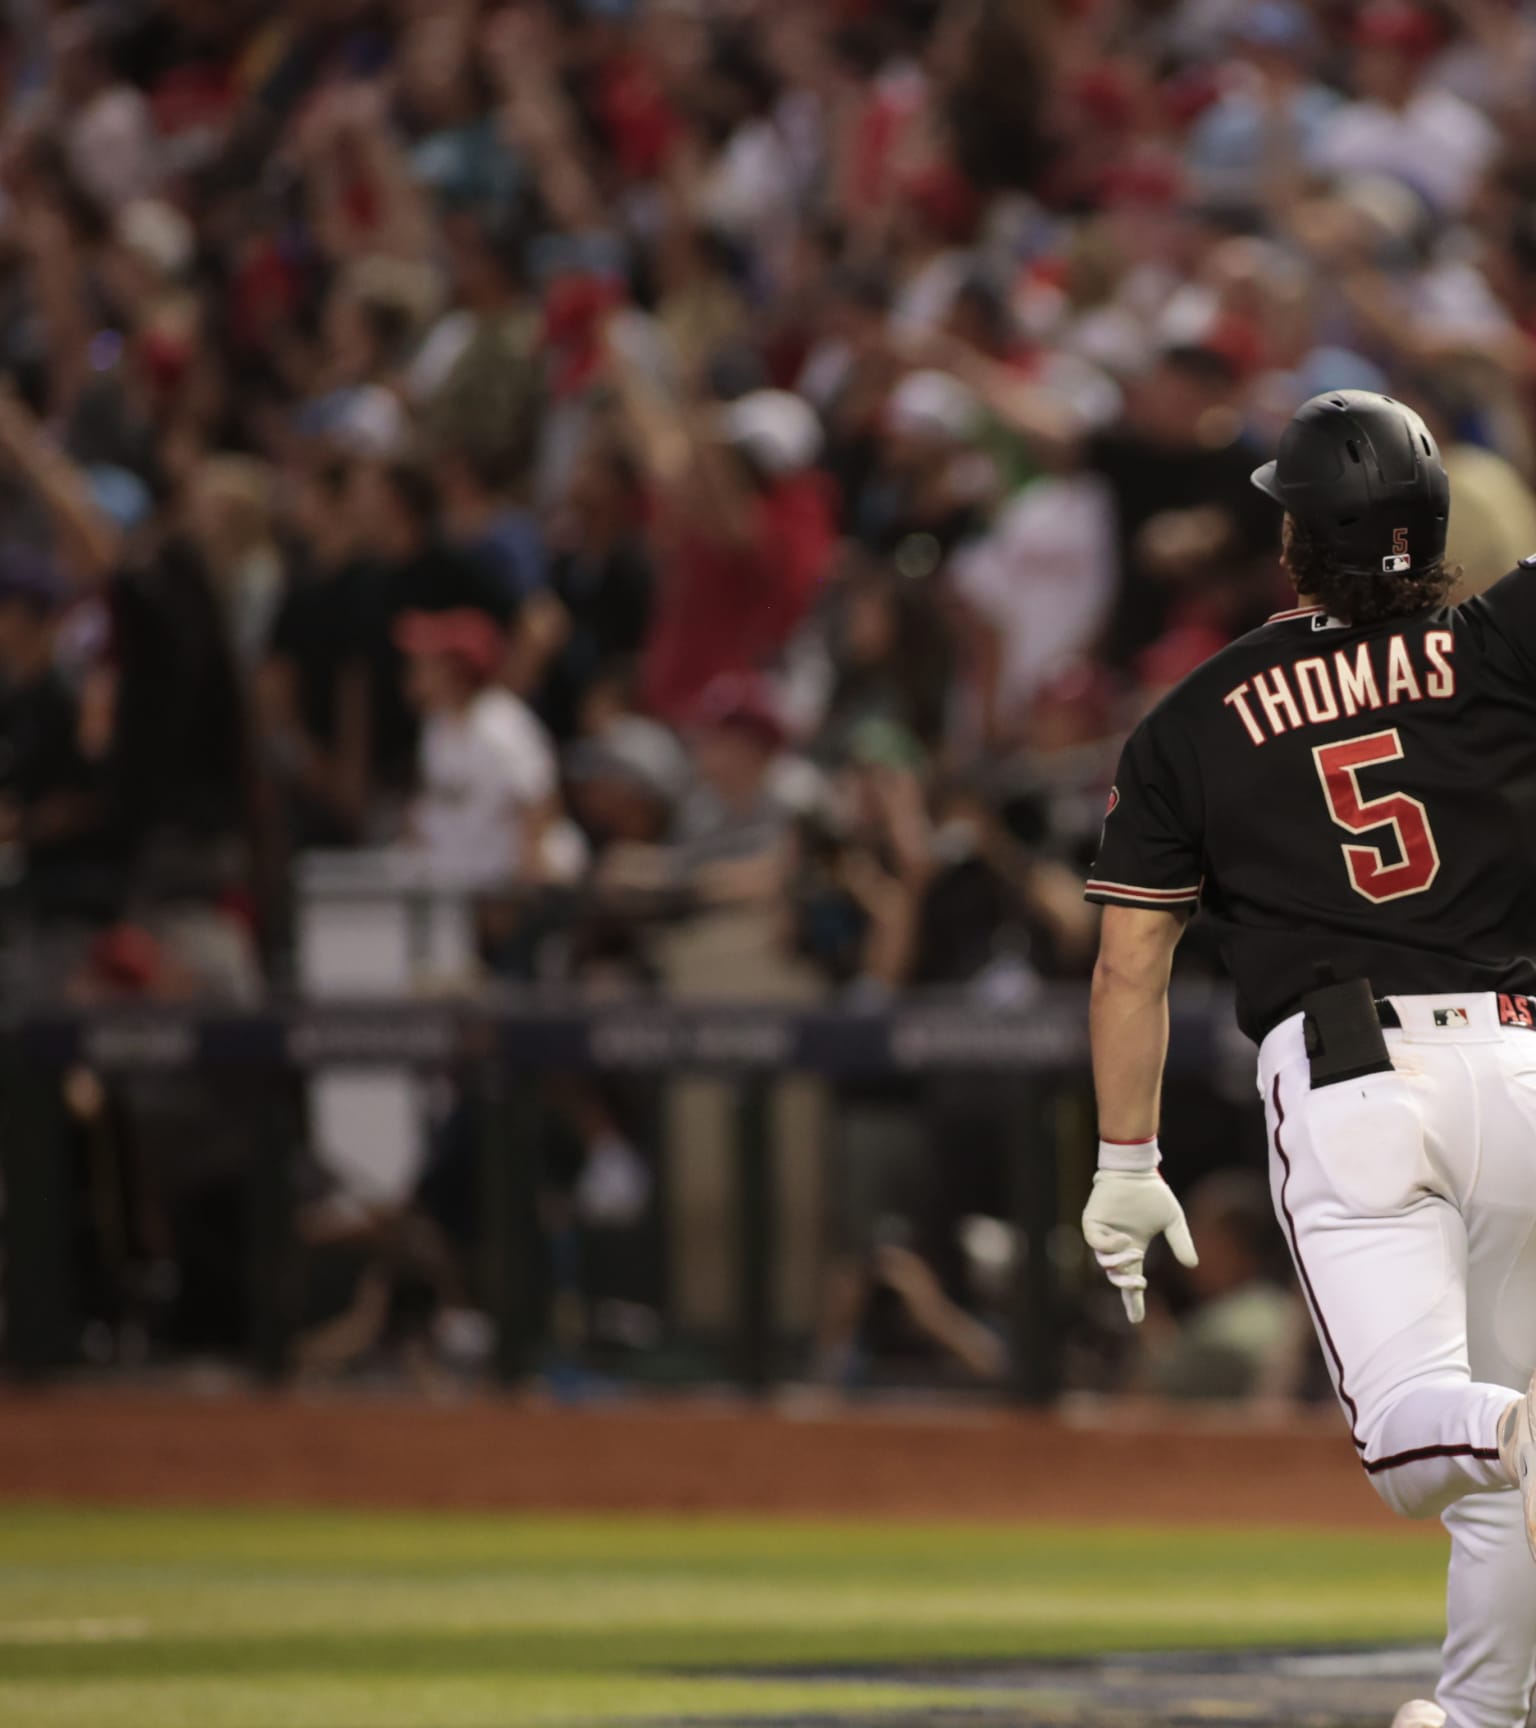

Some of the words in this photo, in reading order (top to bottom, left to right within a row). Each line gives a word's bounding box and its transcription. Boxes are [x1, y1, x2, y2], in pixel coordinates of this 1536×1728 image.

[1392, 527, 1408, 555] 5
[1223, 629, 1455, 747] THOMAS
[1311, 727, 1441, 905] 5
